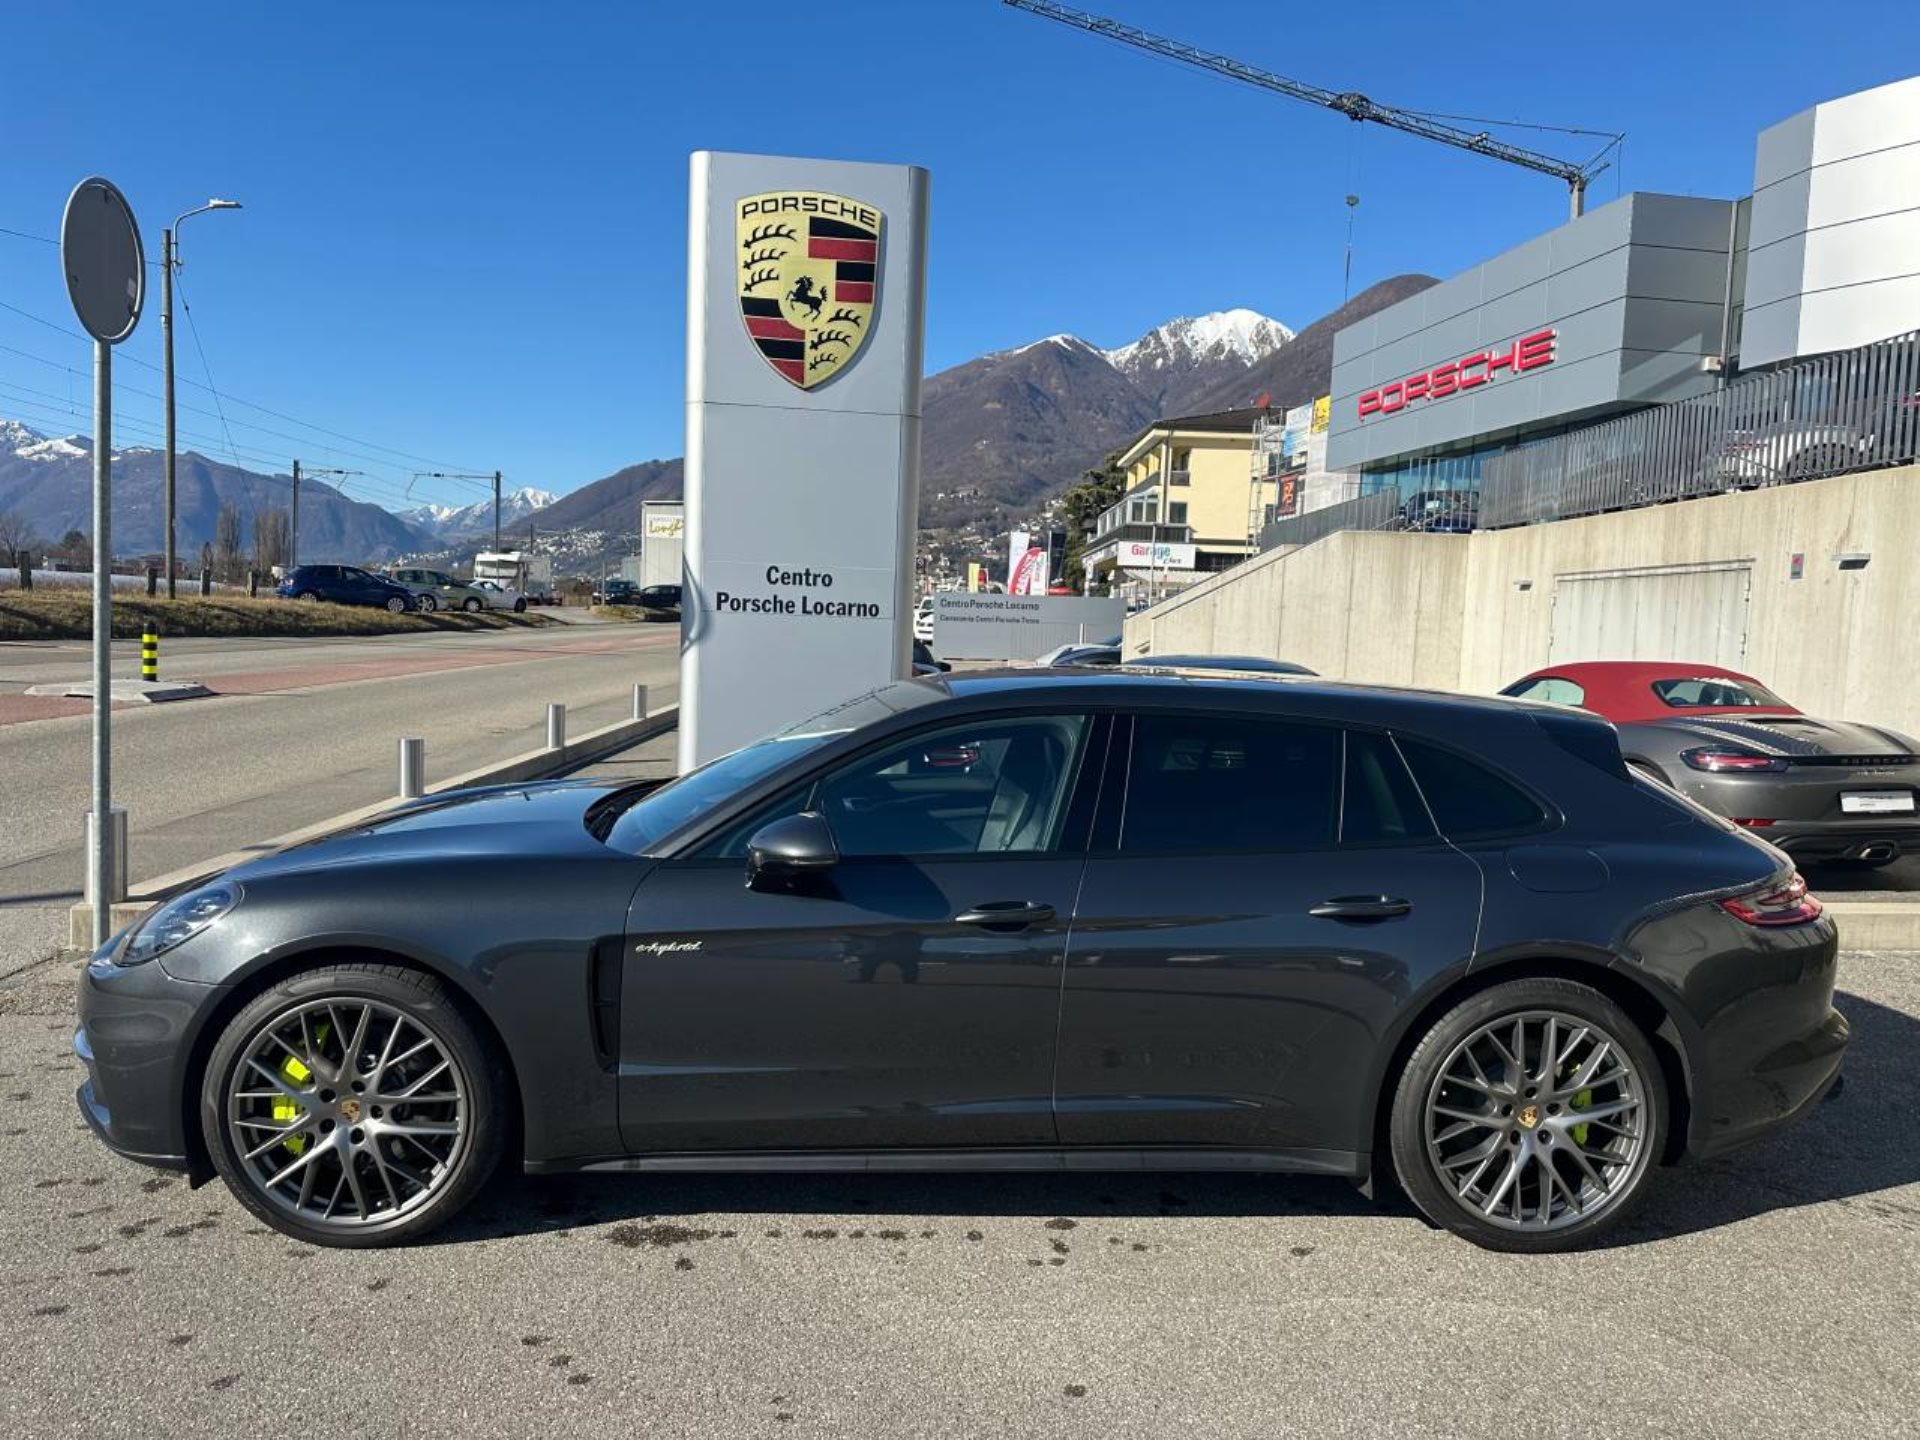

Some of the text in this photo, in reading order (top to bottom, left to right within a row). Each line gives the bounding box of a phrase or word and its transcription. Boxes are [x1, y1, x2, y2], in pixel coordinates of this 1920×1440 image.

[741, 196, 877, 229] PORSCHE
[1358, 327, 1558, 424] PORSCHE
[1131, 544, 1171, 559] Garage
[766, 565, 833, 587] Centro
[716, 592, 880, 617] Porsche Locarno
[940, 599, 1040, 611] Centro Porsche Locarno
